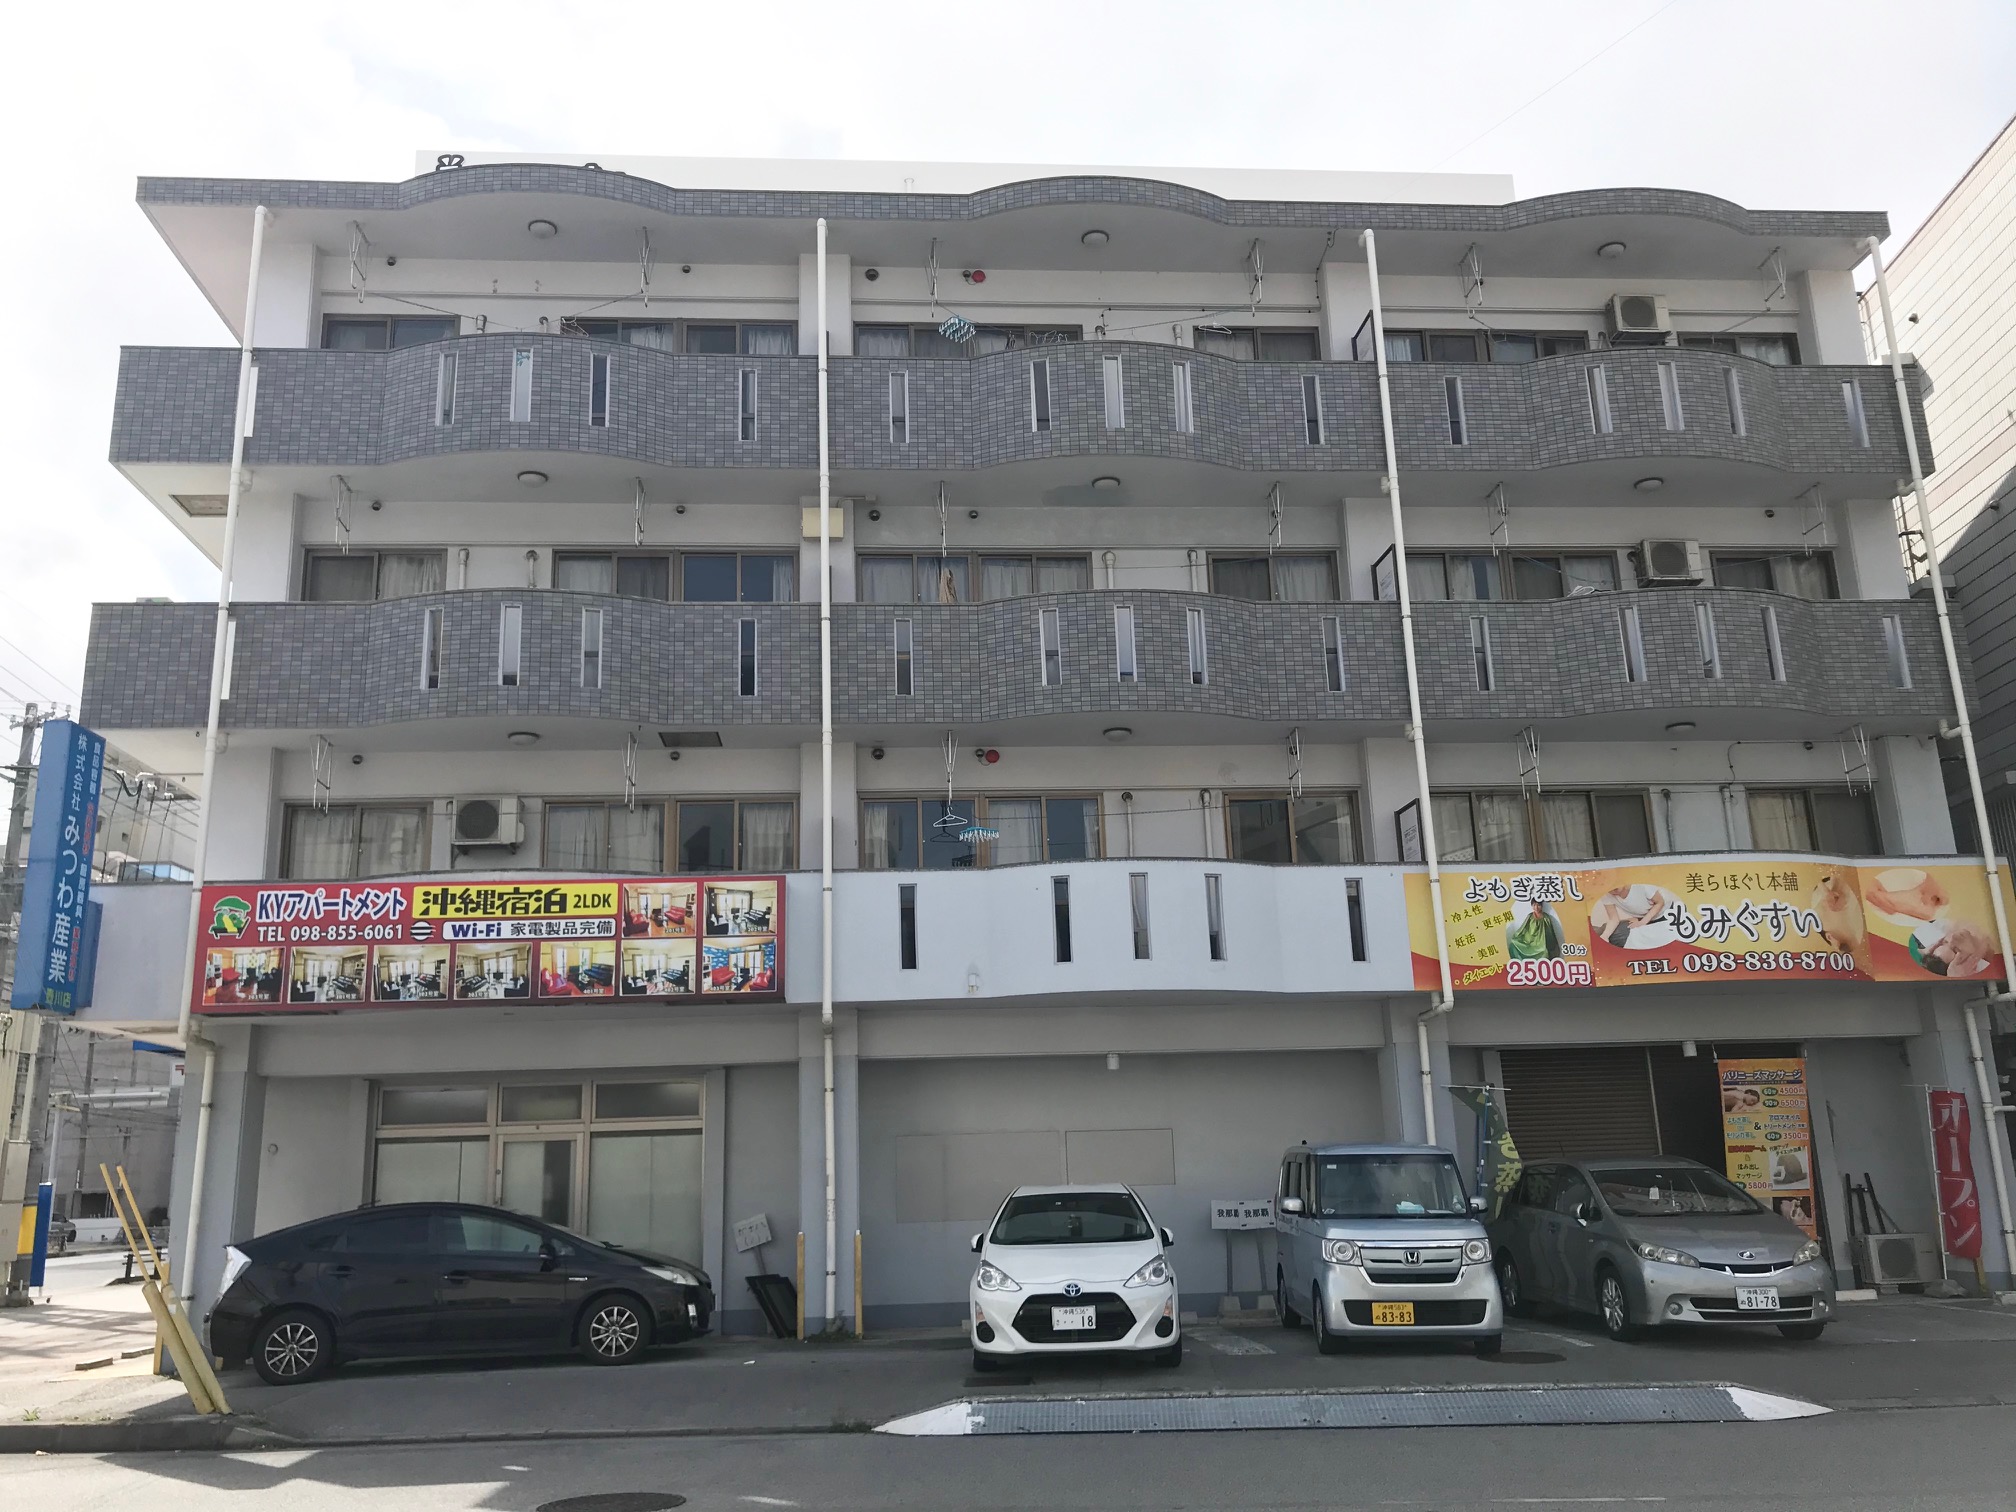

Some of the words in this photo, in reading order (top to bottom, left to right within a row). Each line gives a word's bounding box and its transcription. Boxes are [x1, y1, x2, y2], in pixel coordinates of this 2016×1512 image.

[1464, 875, 1584, 901] よもぎ蒸し
[1685, 871, 1799, 893] 美らほぐし本舗
[257, 888, 406, 922] KYアパートメント
[419, 887, 568, 916] 沖縄宿泊
[573, 893, 612, 908] 2LDK
[257, 926, 286, 942] TEL
[290, 924, 403, 941] 098-855-6061
[451, 922, 502, 938] Wi-Fi
[511, 921, 613, 937] 家電製品完備
[1666, 899, 1822, 942] もみぐすい
[1562, 944, 1587, 955] 30分
[1507, 958, 1591, 986] 2500円
[1628, 959, 1677, 976] TEL
[1683, 951, 1855, 973] 098-836-8700
[1936, 1098, 1978, 1249] オープン
[1746, 1296, 1777, 1308] 81-78
[1381, 1311, 1412, 1323] 83-83
